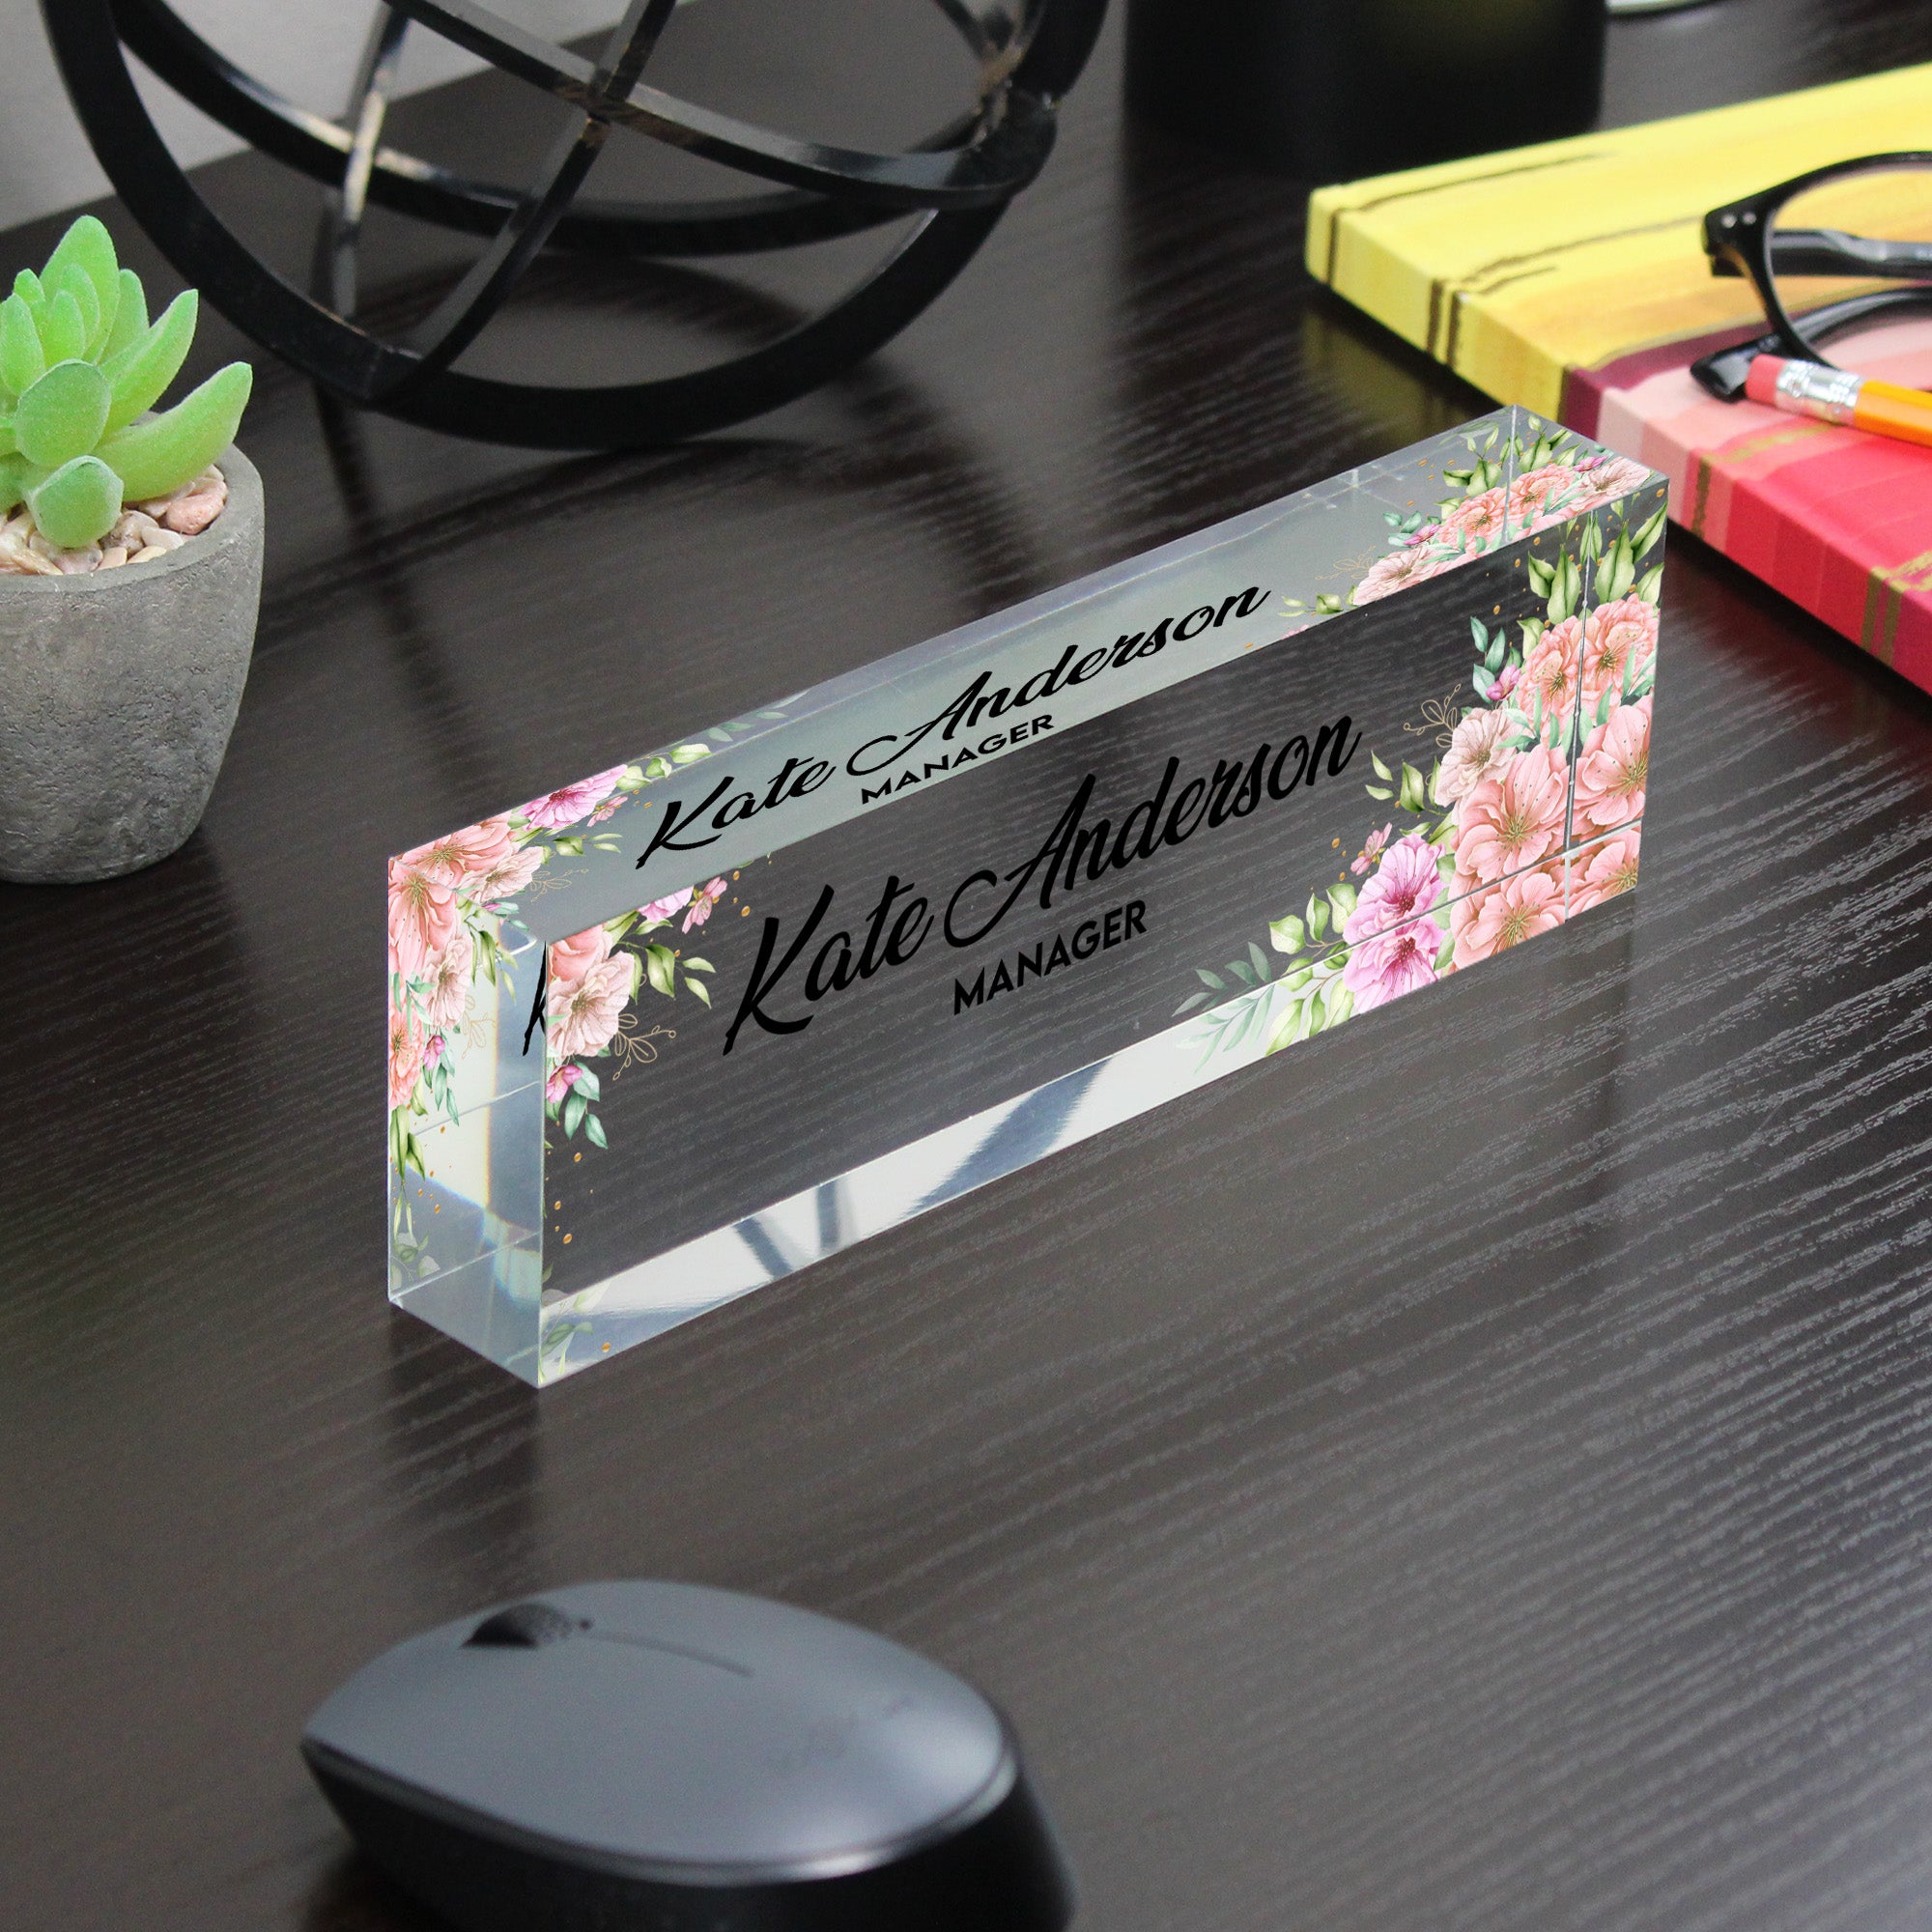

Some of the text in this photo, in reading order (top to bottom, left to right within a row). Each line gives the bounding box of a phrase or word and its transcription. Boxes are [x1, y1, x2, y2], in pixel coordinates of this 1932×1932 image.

[635, 585, 1271, 870] Kate Anderson
[861, 714, 1055, 805] MANAGER
[723, 874, 936, 1057] Kate
[943, 715, 1364, 949] Anderson
[952, 899, 1147, 1016] MANAGER
